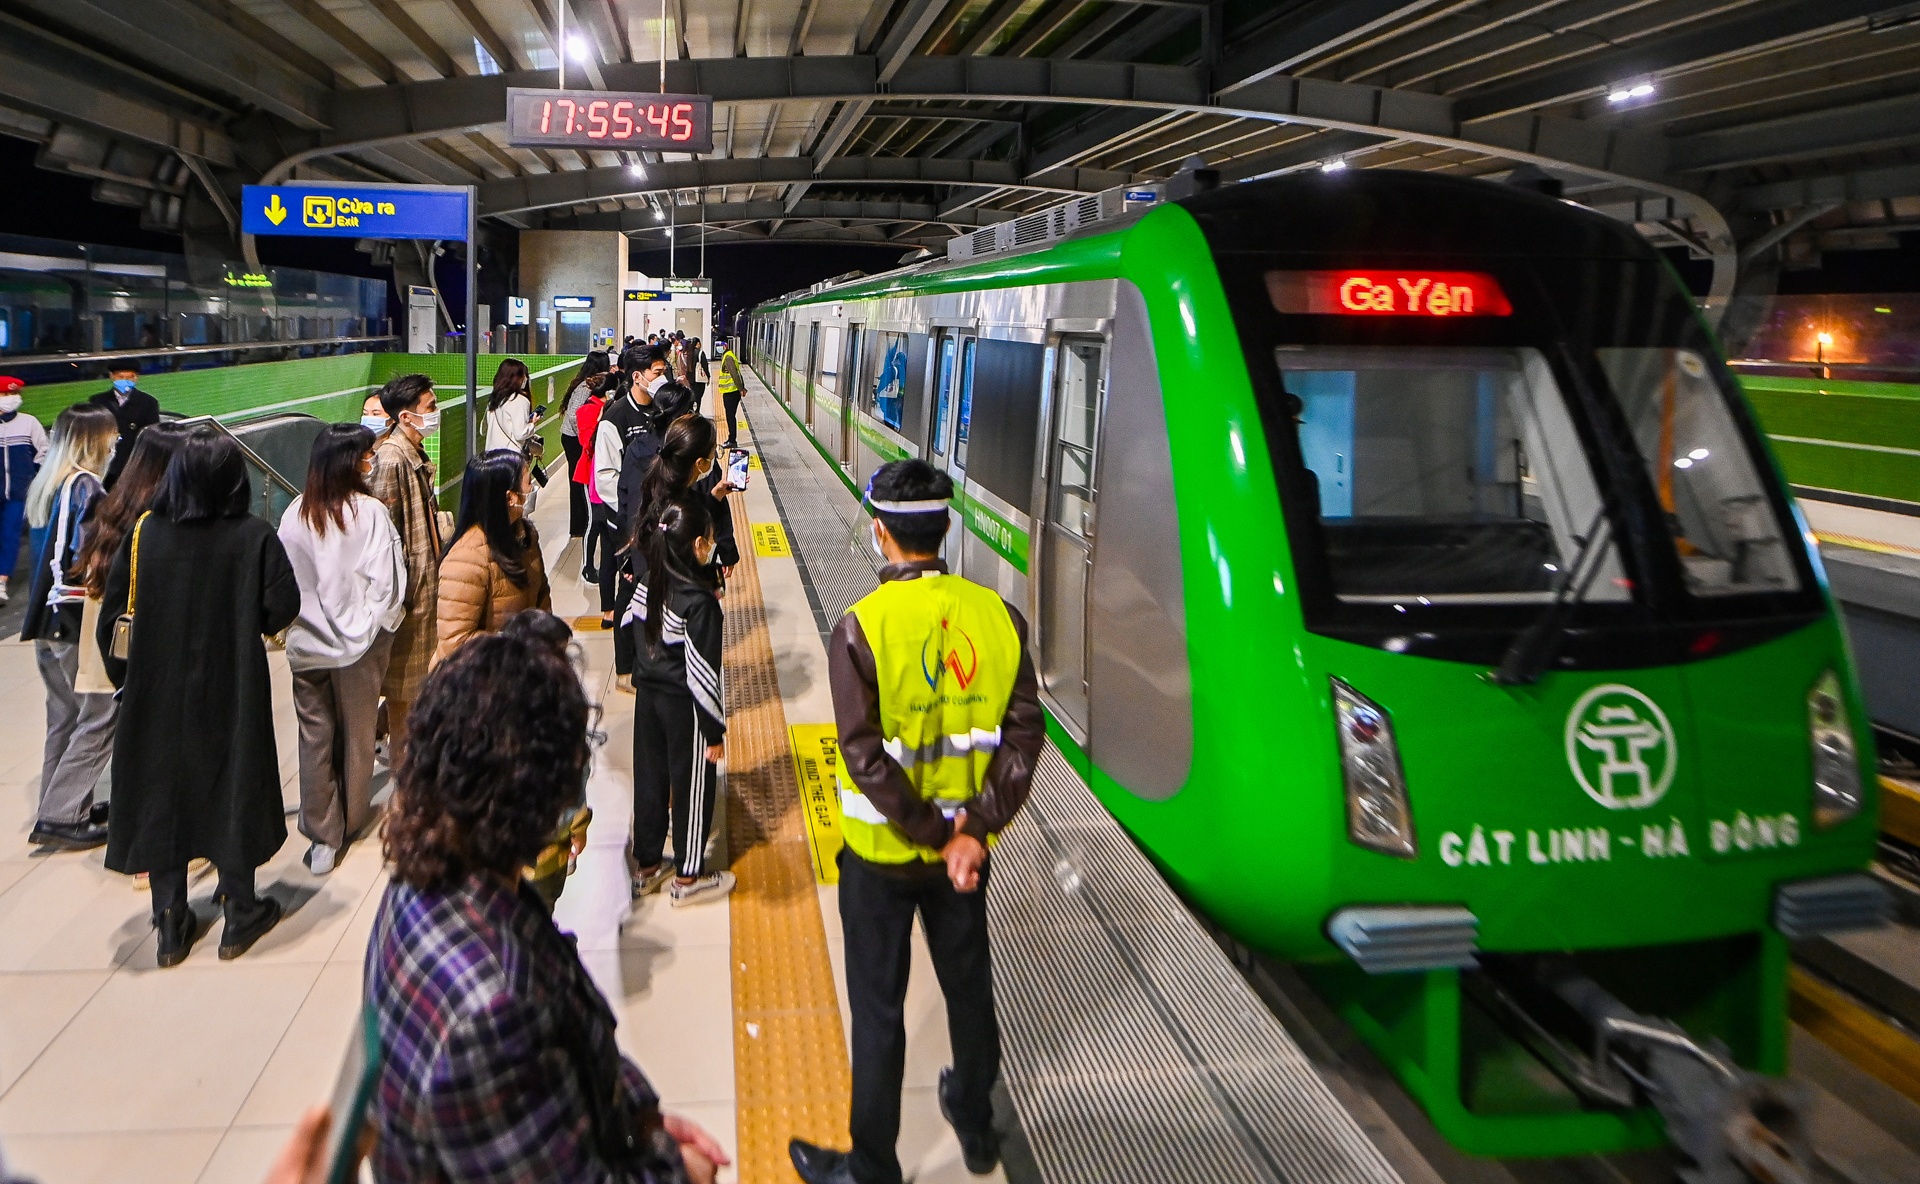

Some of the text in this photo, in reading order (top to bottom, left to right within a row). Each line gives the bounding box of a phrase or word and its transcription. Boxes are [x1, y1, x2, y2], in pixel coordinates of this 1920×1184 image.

[540, 99, 692, 141] 17:55:45
[337, 215, 360, 227] Exit
[377, 202, 396, 215] ra
[1340, 277, 1395, 311] Ga
[1001, 526, 1012, 554] 01
[810, 784, 826, 802] THE
[815, 806, 832, 828] GAP
[1439, 822, 1516, 867] CÁT
[1526, 826, 1612, 866] LINH
[1640, 814, 1691, 859] HÀ
